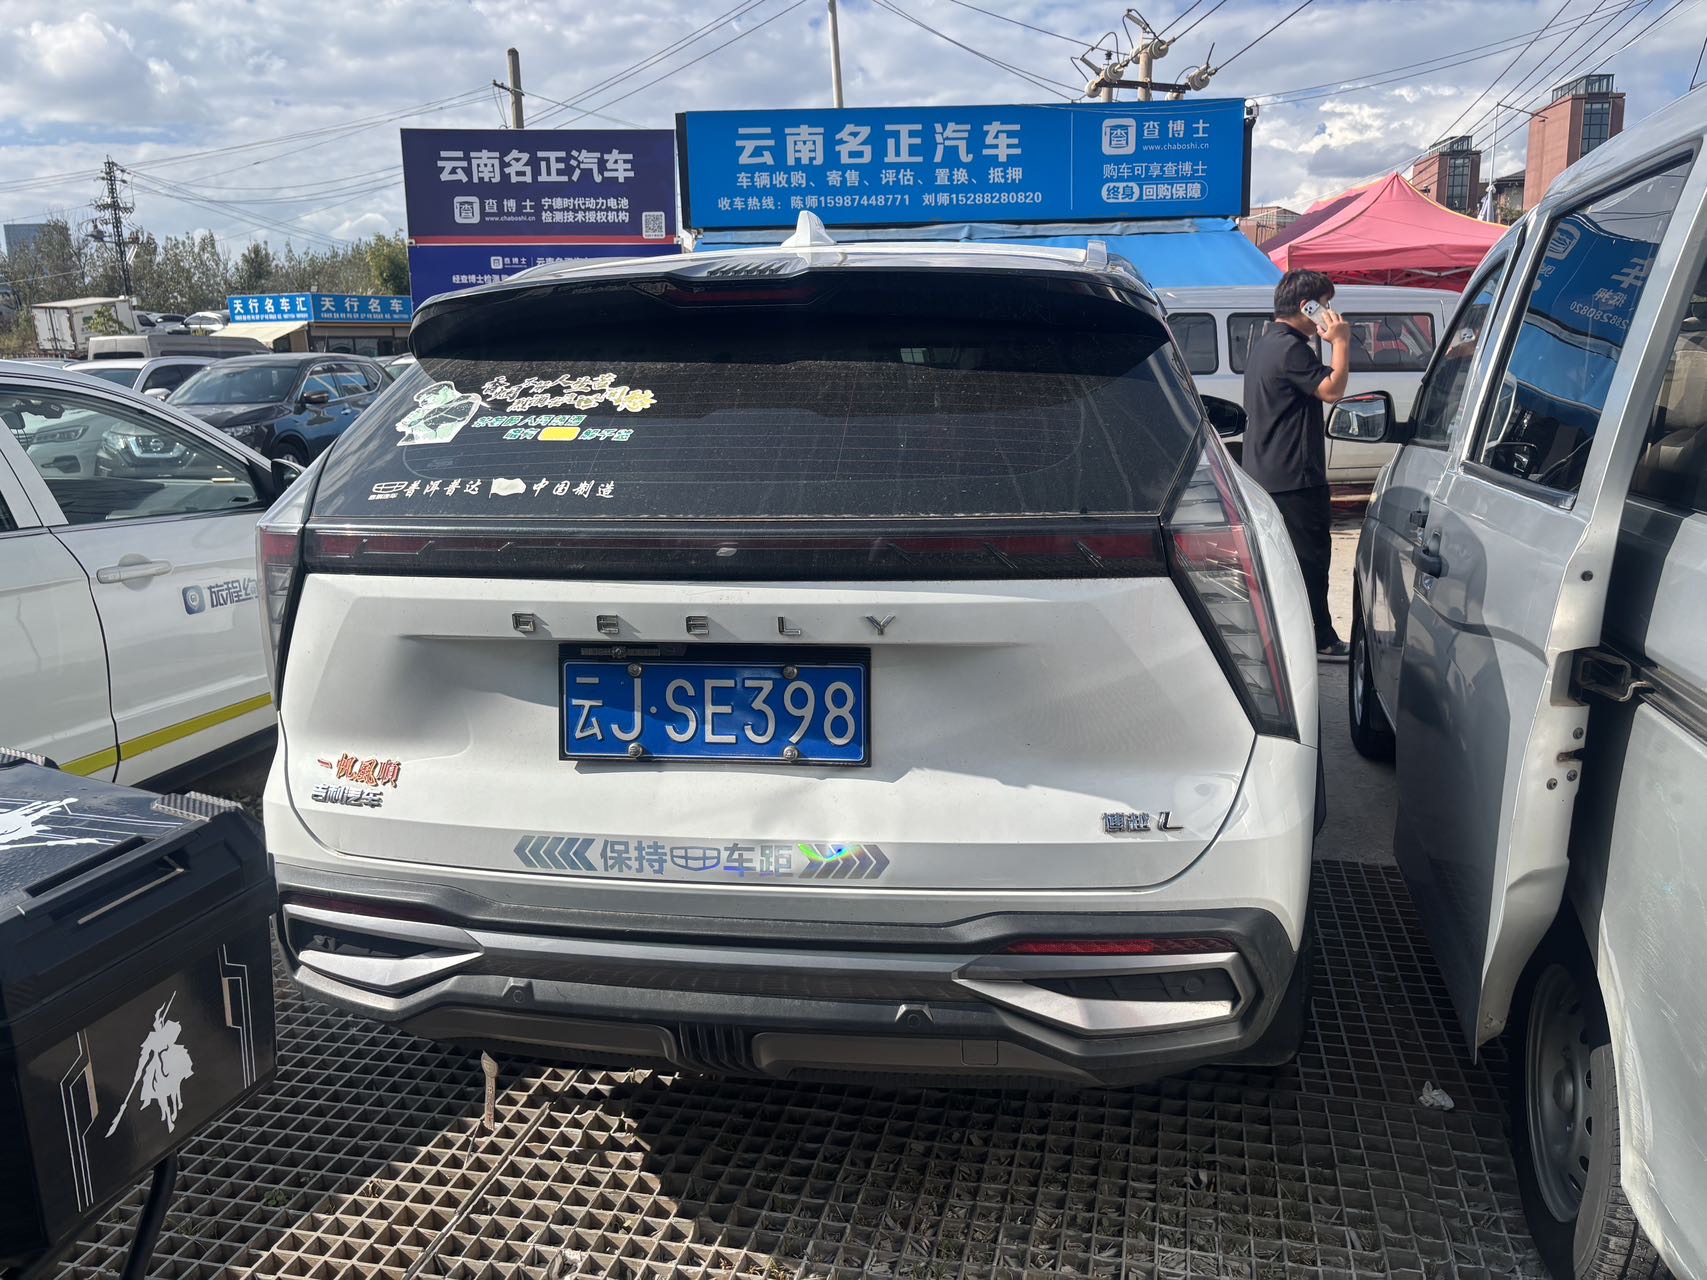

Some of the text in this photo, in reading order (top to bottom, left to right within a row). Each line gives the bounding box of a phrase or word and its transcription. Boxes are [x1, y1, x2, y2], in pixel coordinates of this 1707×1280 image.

[1142, 119, 1210, 139] 查博士
[736, 121, 1022, 166] 云南名正汽车
[1142, 142, 1209, 151] www.chaboshi.cn
[437, 149, 635, 183] 云南名正汽车
[1103, 161, 1208, 179] 购车可享查博士
[1106, 182, 1202, 200] 终身 回购保障
[484, 198, 535, 213] 查博士
[541, 197, 629, 210] 宁德时代动力电池
[791, 194, 910, 210] 陈师15987448771
[922, 191, 1042, 207] 刘师15288280820
[541, 211, 630, 224] 检测技术授权机构
[233, 297, 308, 314] 天行名车汇
[320, 297, 404, 313] 天行名车
[532, 477, 615, 499] 中国制造
[511, 612, 897, 637] GEELY
[1157, 811, 1184, 832] L
[600, 839, 795, 878] 保持 车距
